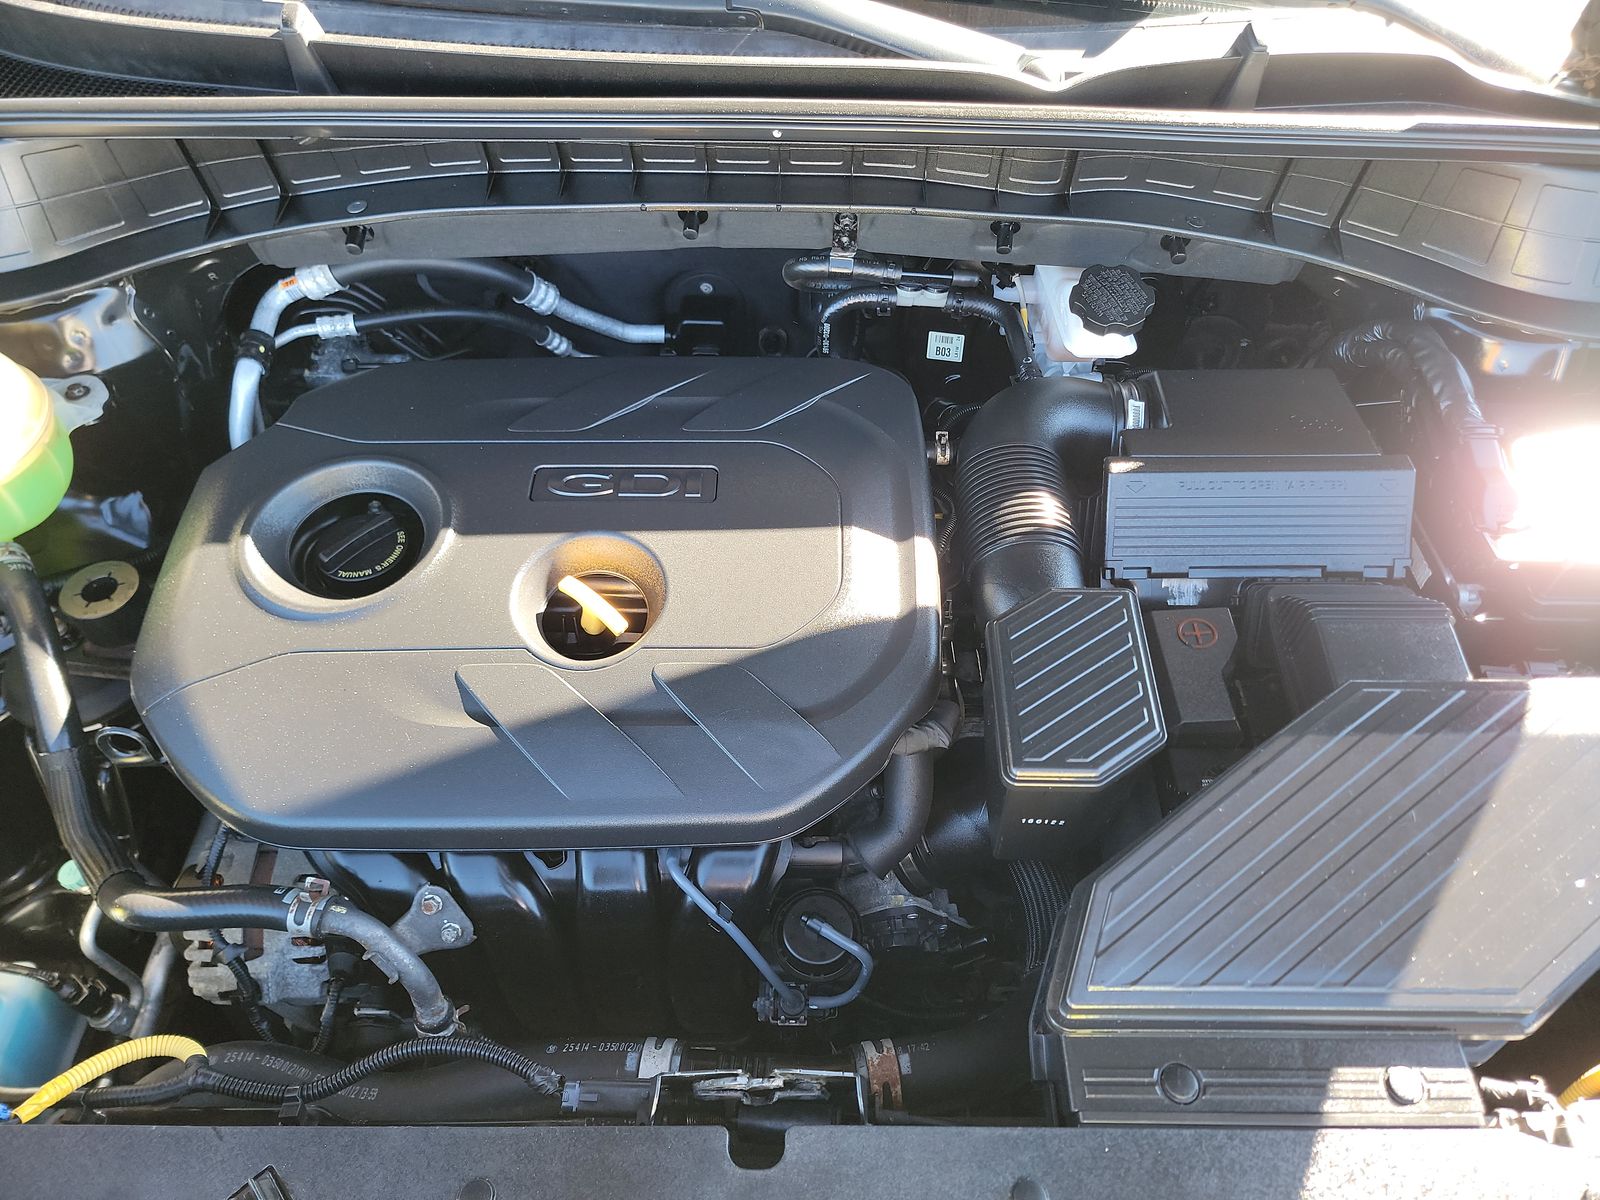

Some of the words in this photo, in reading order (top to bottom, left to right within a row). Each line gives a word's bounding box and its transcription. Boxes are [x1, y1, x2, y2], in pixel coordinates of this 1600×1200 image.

[935, 346, 951, 358] B03
[548, 473, 702, 497] GDI
[396, 530, 406, 544] SEE
[375, 544, 404, 572] OWNER'S
[337, 568, 373, 578] MANUAL
